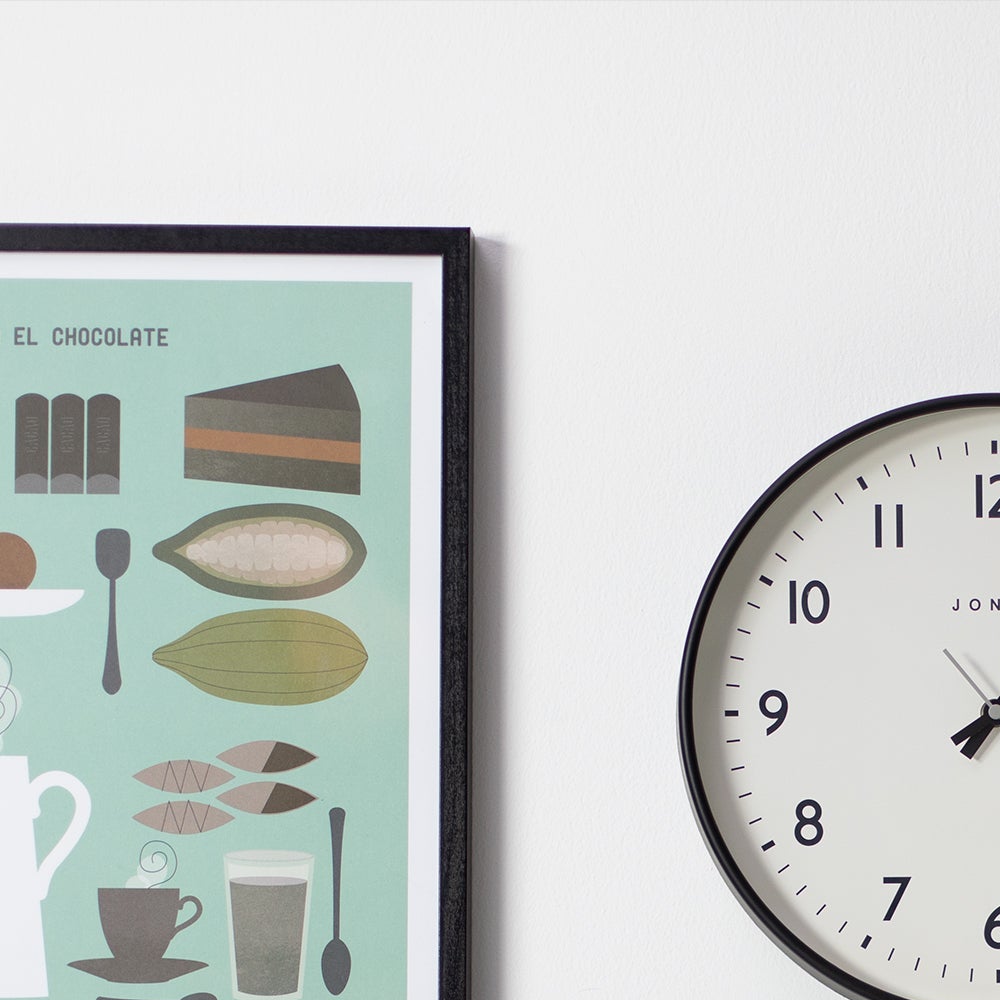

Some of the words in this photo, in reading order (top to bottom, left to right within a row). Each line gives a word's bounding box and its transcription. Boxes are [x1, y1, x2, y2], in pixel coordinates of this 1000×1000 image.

[14, 327, 38, 345] EL
[52, 327, 169, 346] CHOCOLATE
[874, 504, 905, 548] 11
[788, 580, 832, 625] 10
[758, 689, 789, 737] 9
[793, 798, 824, 847] 8
[882, 876, 912, 921] 7
